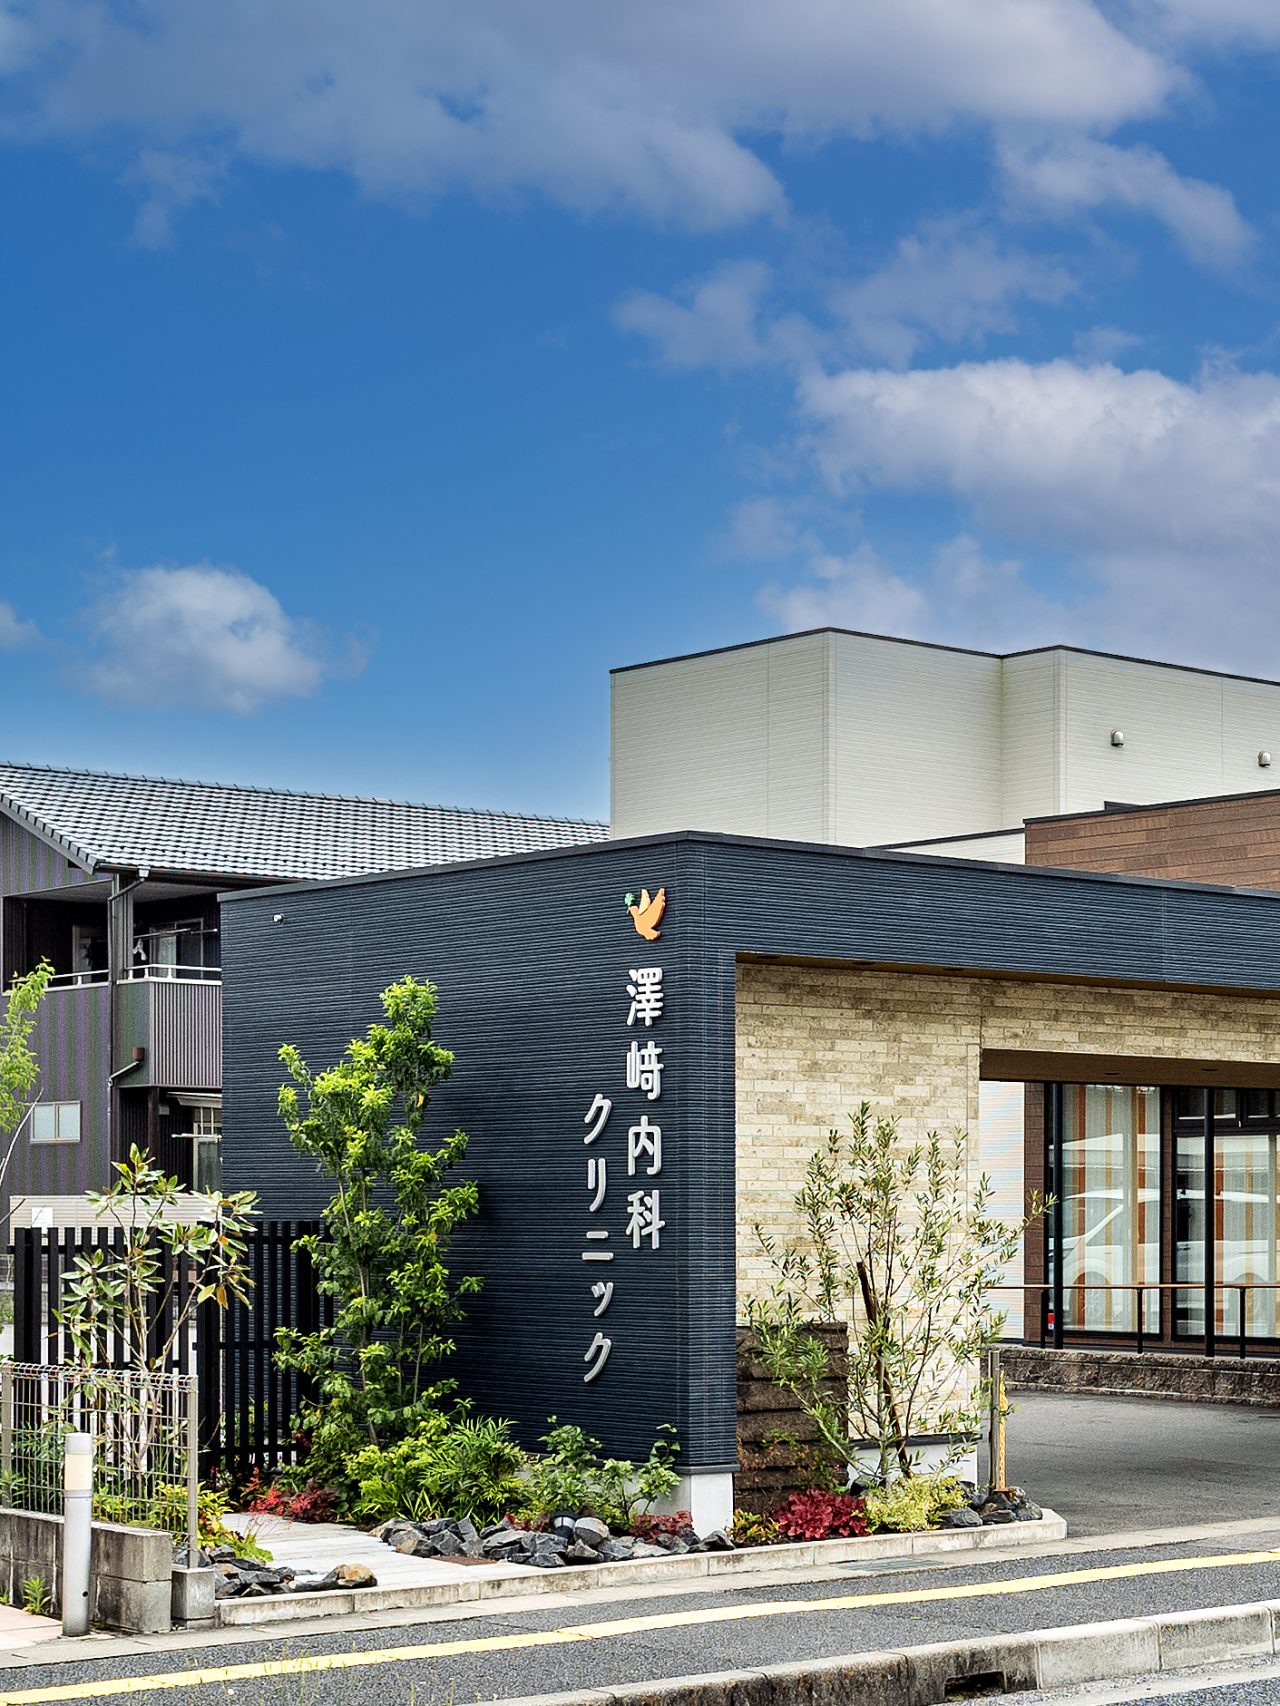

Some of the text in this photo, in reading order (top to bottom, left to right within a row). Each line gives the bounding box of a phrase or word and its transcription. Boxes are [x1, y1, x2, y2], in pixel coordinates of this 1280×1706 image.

[582, 1093, 614, 1383] クリニック
